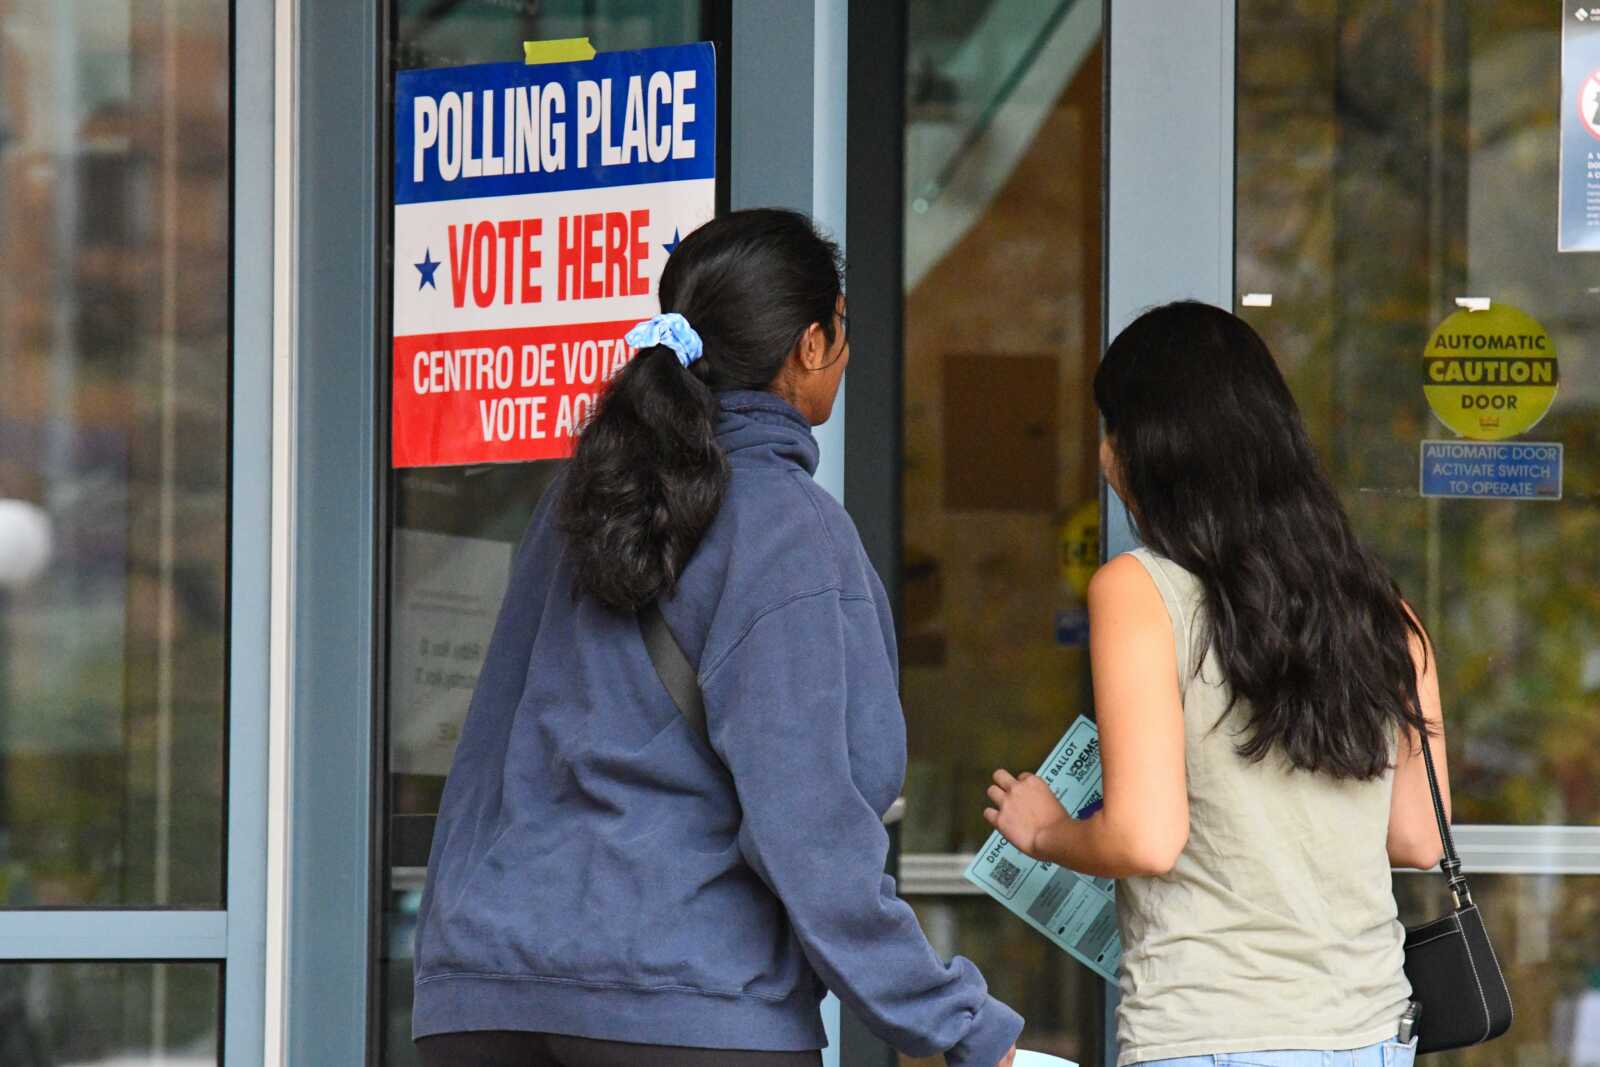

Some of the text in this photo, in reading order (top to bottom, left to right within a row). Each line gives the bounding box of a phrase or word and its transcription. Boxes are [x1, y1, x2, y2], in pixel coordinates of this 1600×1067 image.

[413, 70, 697, 183] POLLING PLACE
[448, 209, 650, 309] VOTE HERE
[1435, 335, 1546, 351] AUTOMATIC
[413, 346, 514, 394] CENTRO
[521, 344, 556, 386] DE
[1429, 361, 1552, 382] CAUTION
[1461, 395, 1518, 410] DOOR
[480, 396, 547, 442] VOTE
[1426, 445, 1557, 461] AUTOMATIC DOOR
[1432, 463, 1551, 479] ACTIVATE SWITCH
[1449, 480, 1468, 494] TO
[1472, 480, 1533, 496] OPERATE
[1050, 741, 1077, 776] BALLOT
